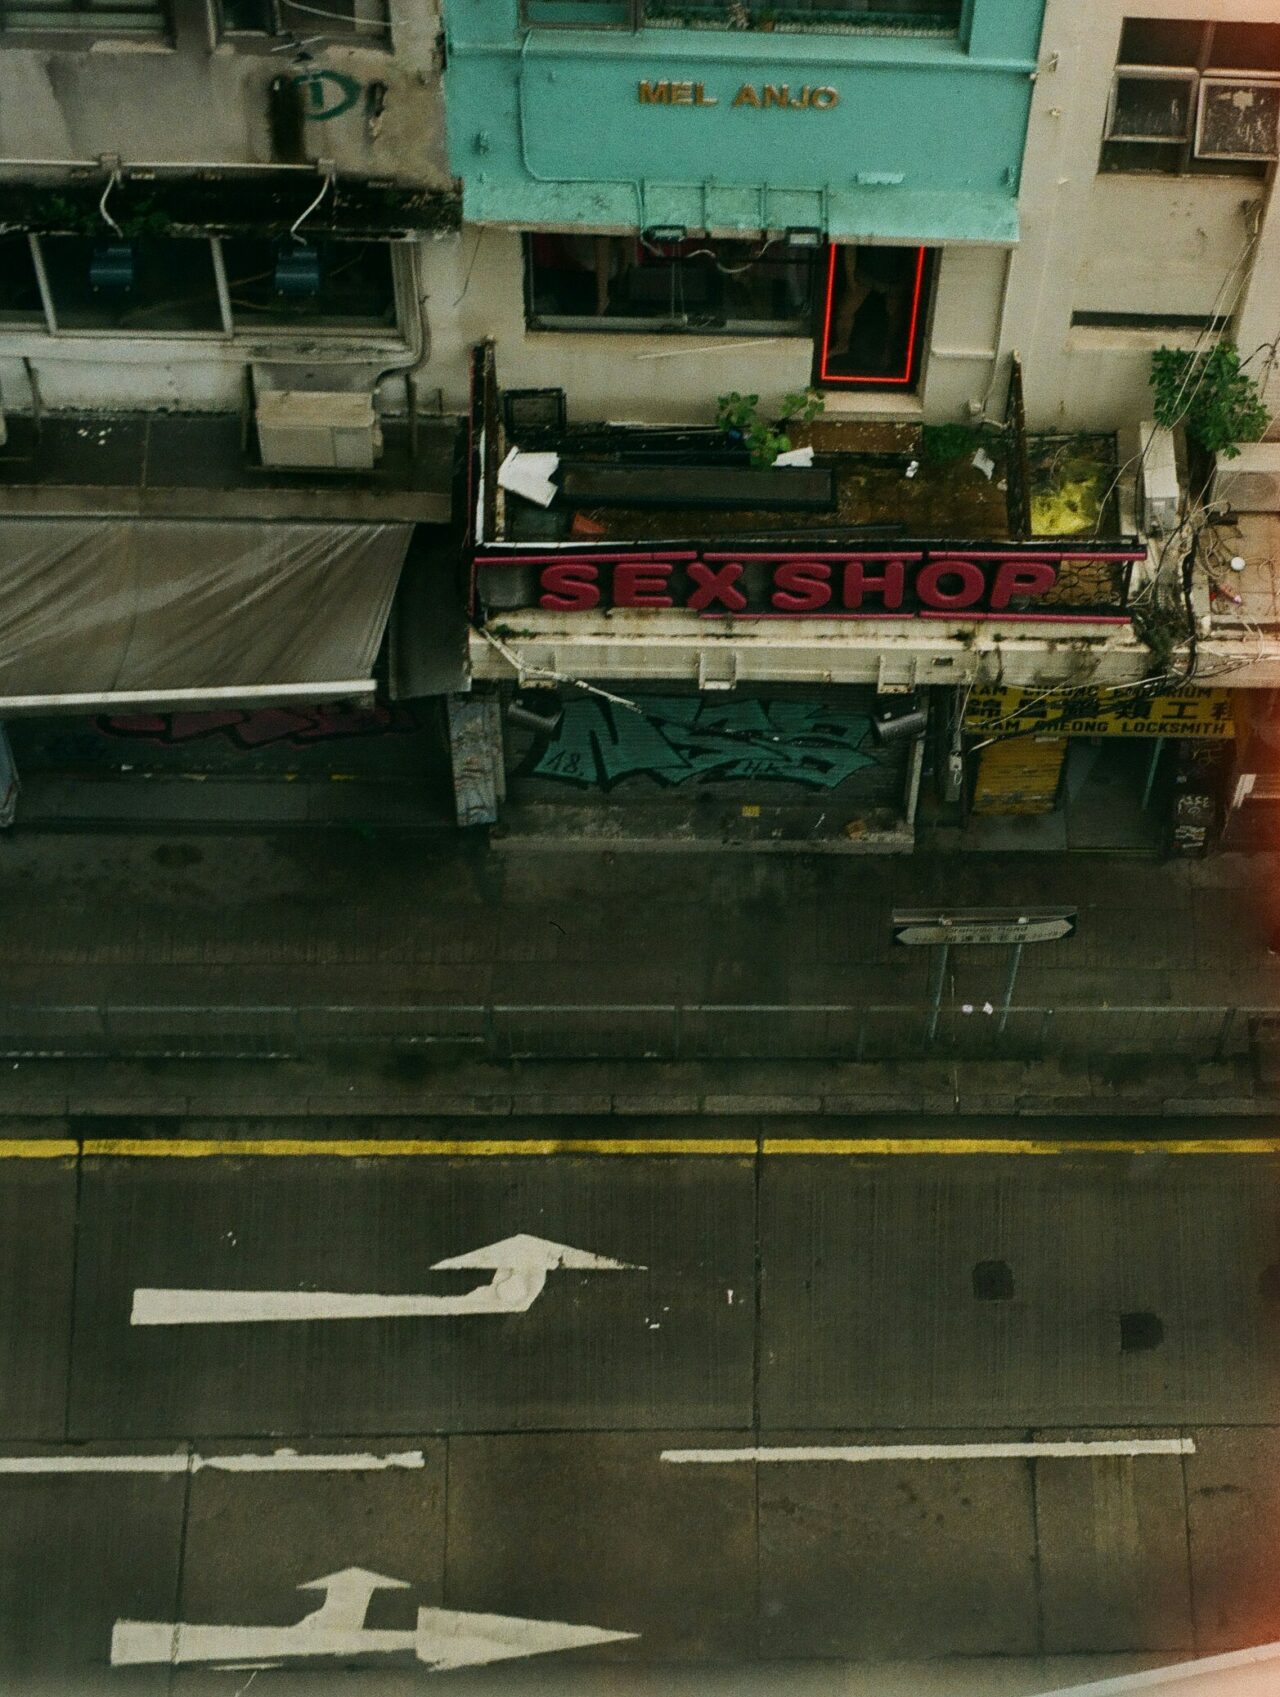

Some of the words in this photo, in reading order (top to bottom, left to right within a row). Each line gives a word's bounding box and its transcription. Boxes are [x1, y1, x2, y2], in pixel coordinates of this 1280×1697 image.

[638, 80, 718, 106] MEL
[732, 82, 839, 110] ANJO
[540, 562, 747, 612] SEX
[771, 561, 1057, 611] SHOP
[1122, 721, 1227, 735] LOCKSMITH
